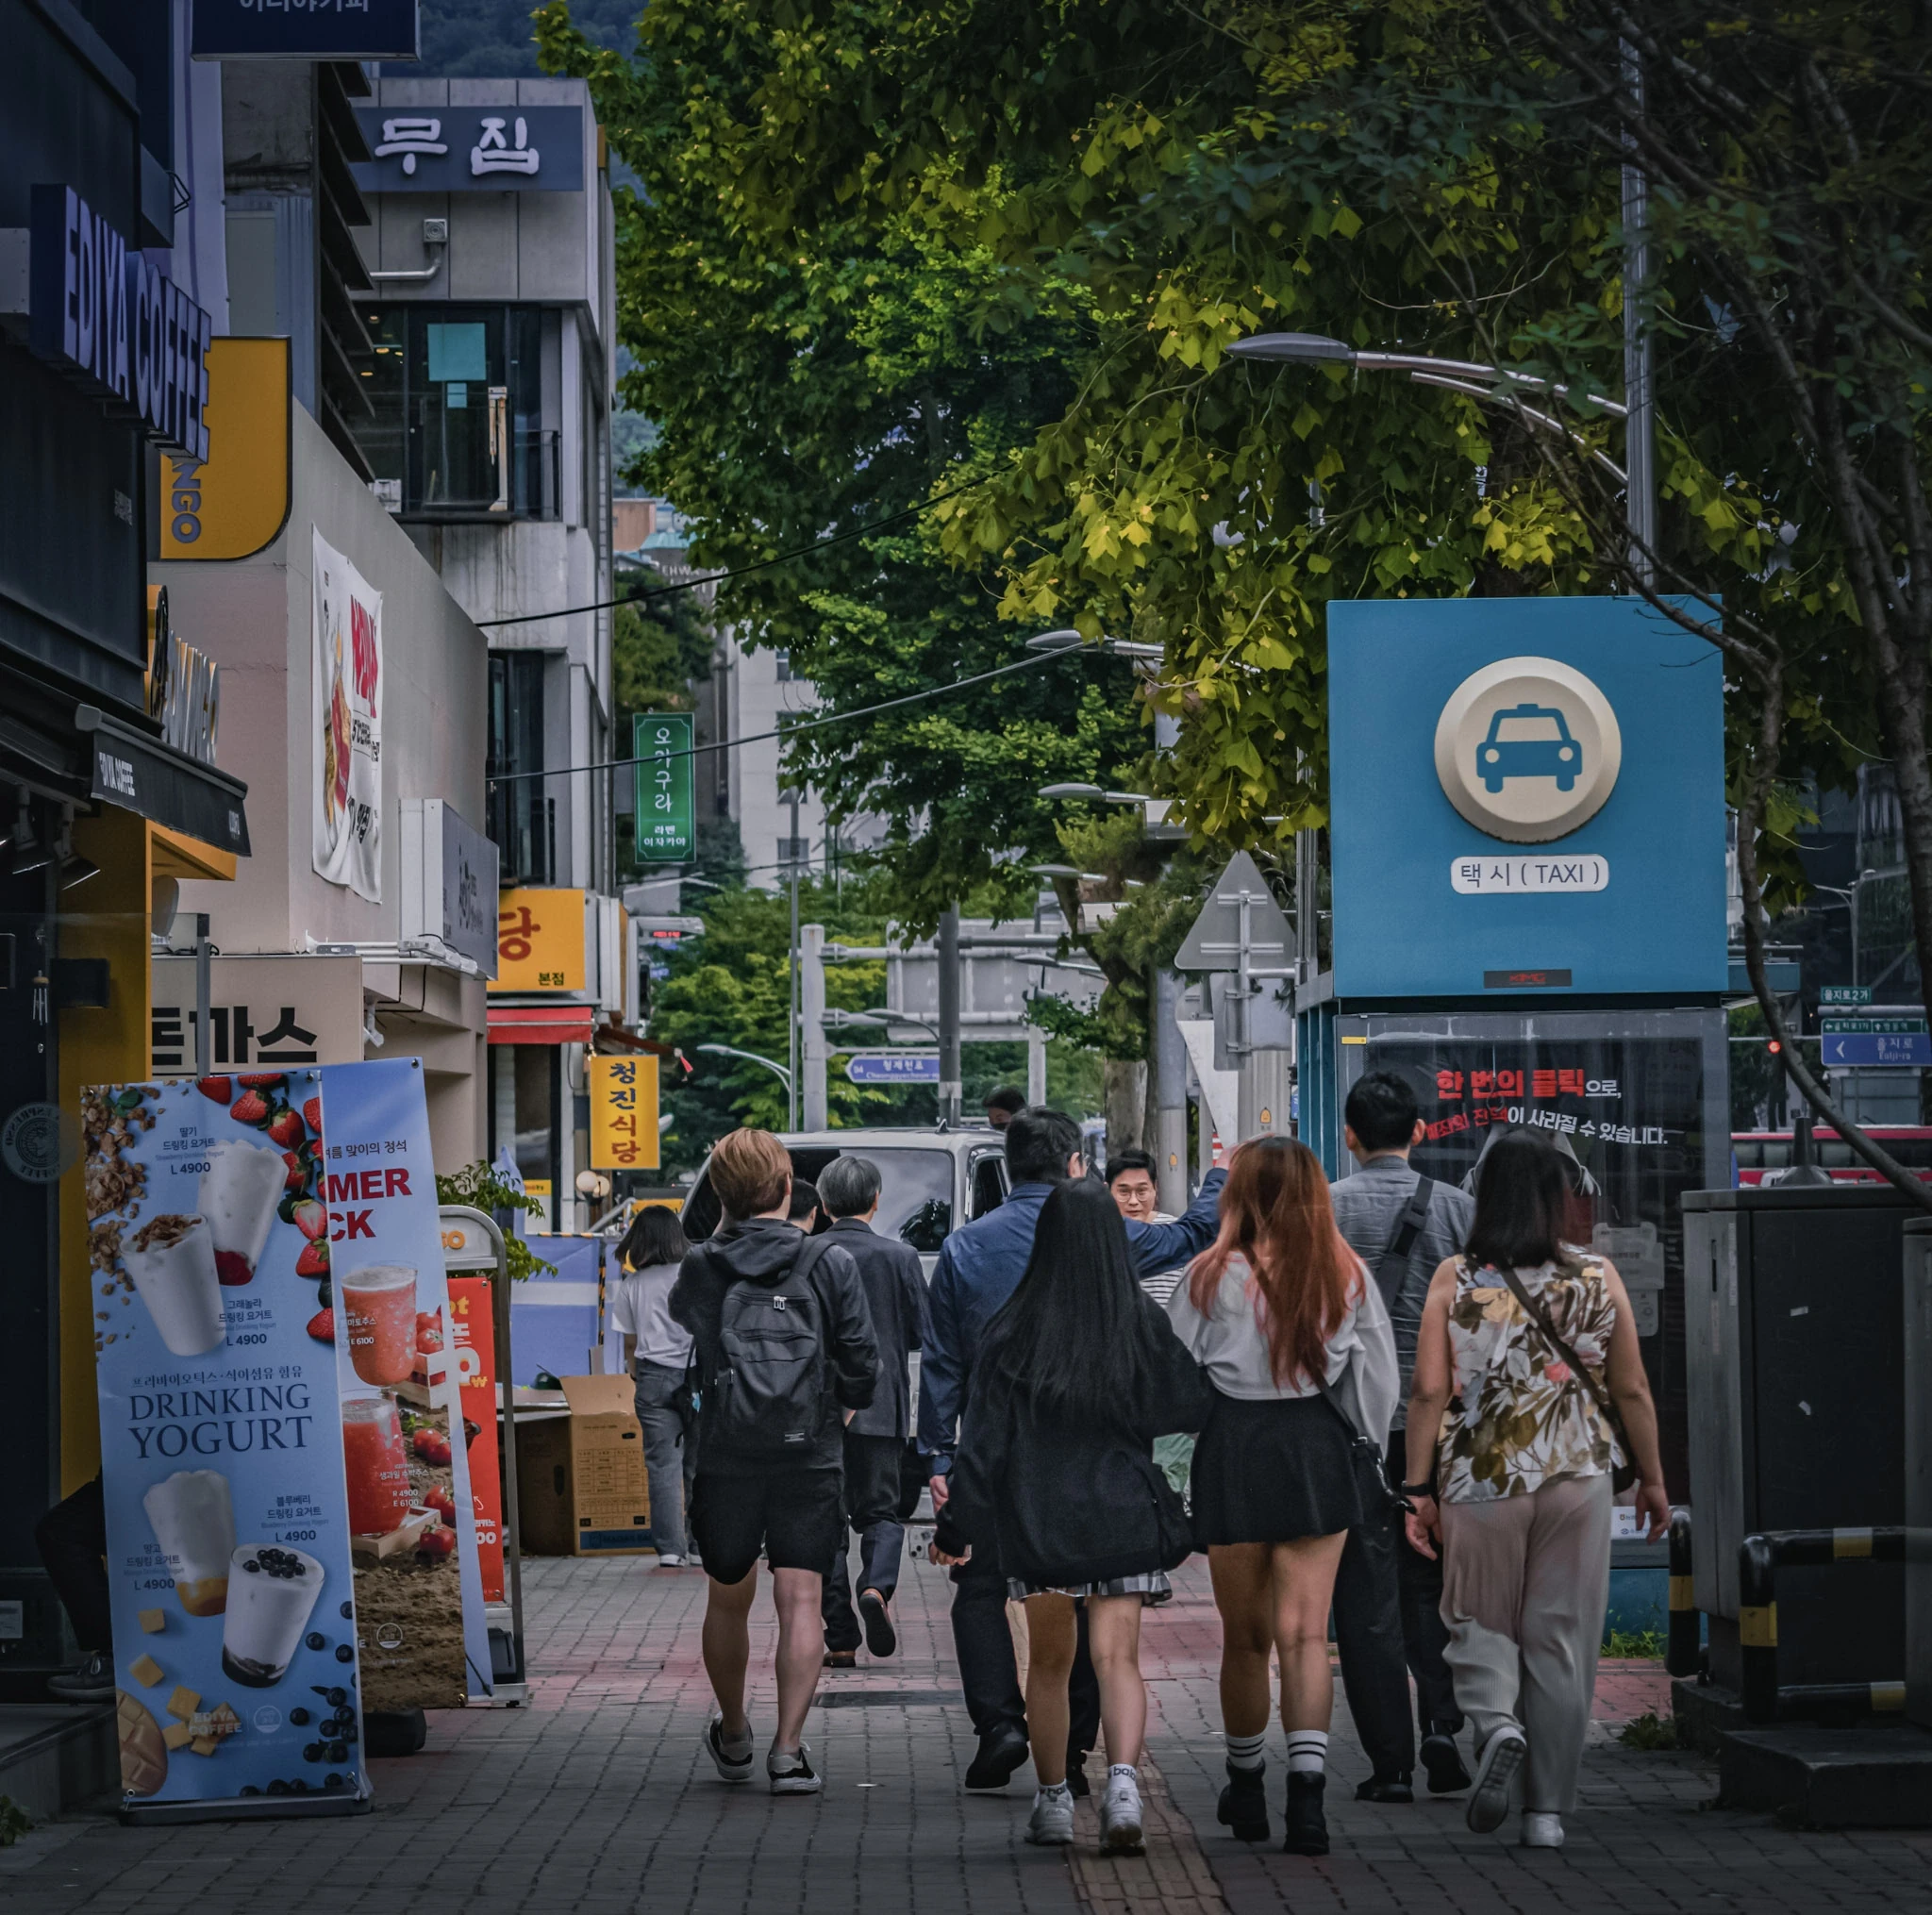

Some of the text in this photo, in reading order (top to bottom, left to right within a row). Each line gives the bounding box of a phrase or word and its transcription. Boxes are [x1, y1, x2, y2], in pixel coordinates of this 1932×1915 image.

[63, 186, 211, 465] EDIYA COFFEE
[643, 837, 686, 847] 이자카야
[538, 973, 564, 986] 본점
[1824, 989, 1868, 1001] 을지로2가
[1877, 1037, 1913, 1052] 을지로
[1436, 1069, 1464, 1099] 한
[1471, 1070, 1524, 1099] 번의
[608, 1061, 641, 1164] 청진식당
[179, 1126, 197, 1138] 딸기
[1527, 1108, 1578, 1135] 사라질
[1579, 1120, 1596, 1138] 수
[1599, 1123, 1669, 1145] 있습니다.
[163, 1138, 216, 1151] 드링킹 요거트
[346, 1142, 380, 1157] 맞이의
[384, 1139, 408, 1153] 정석
[171, 1161, 211, 1174] L 4900
[327, 1168, 412, 1203] MER
[330, 1208, 376, 1241] CK
[226, 1298, 261, 1309] 그래놀라
[219, 1309, 272, 1324] 드링킹 요거트
[347, 1317, 377, 1327] 마토주스
[226, 1333, 267, 1346] L 4900
[357, 1336, 375, 1345] 6100
[128, 1383, 311, 1421] DRINKING
[128, 1416, 312, 1459] YOGURT
[399, 1489, 419, 1497] 4900
[276, 1494, 311, 1507] 블루베리
[400, 1499, 419, 1507] 6100
[267, 1507, 322, 1520] 드링킹 요거트
[275, 1529, 316, 1542] L 4900
[126, 1555, 180, 1568] 드링킹 요거트
[134, 1577, 175, 1590] L 4900
[194, 1710, 236, 1723] EDIYA
[189, 1722, 242, 1737] COFFEE
